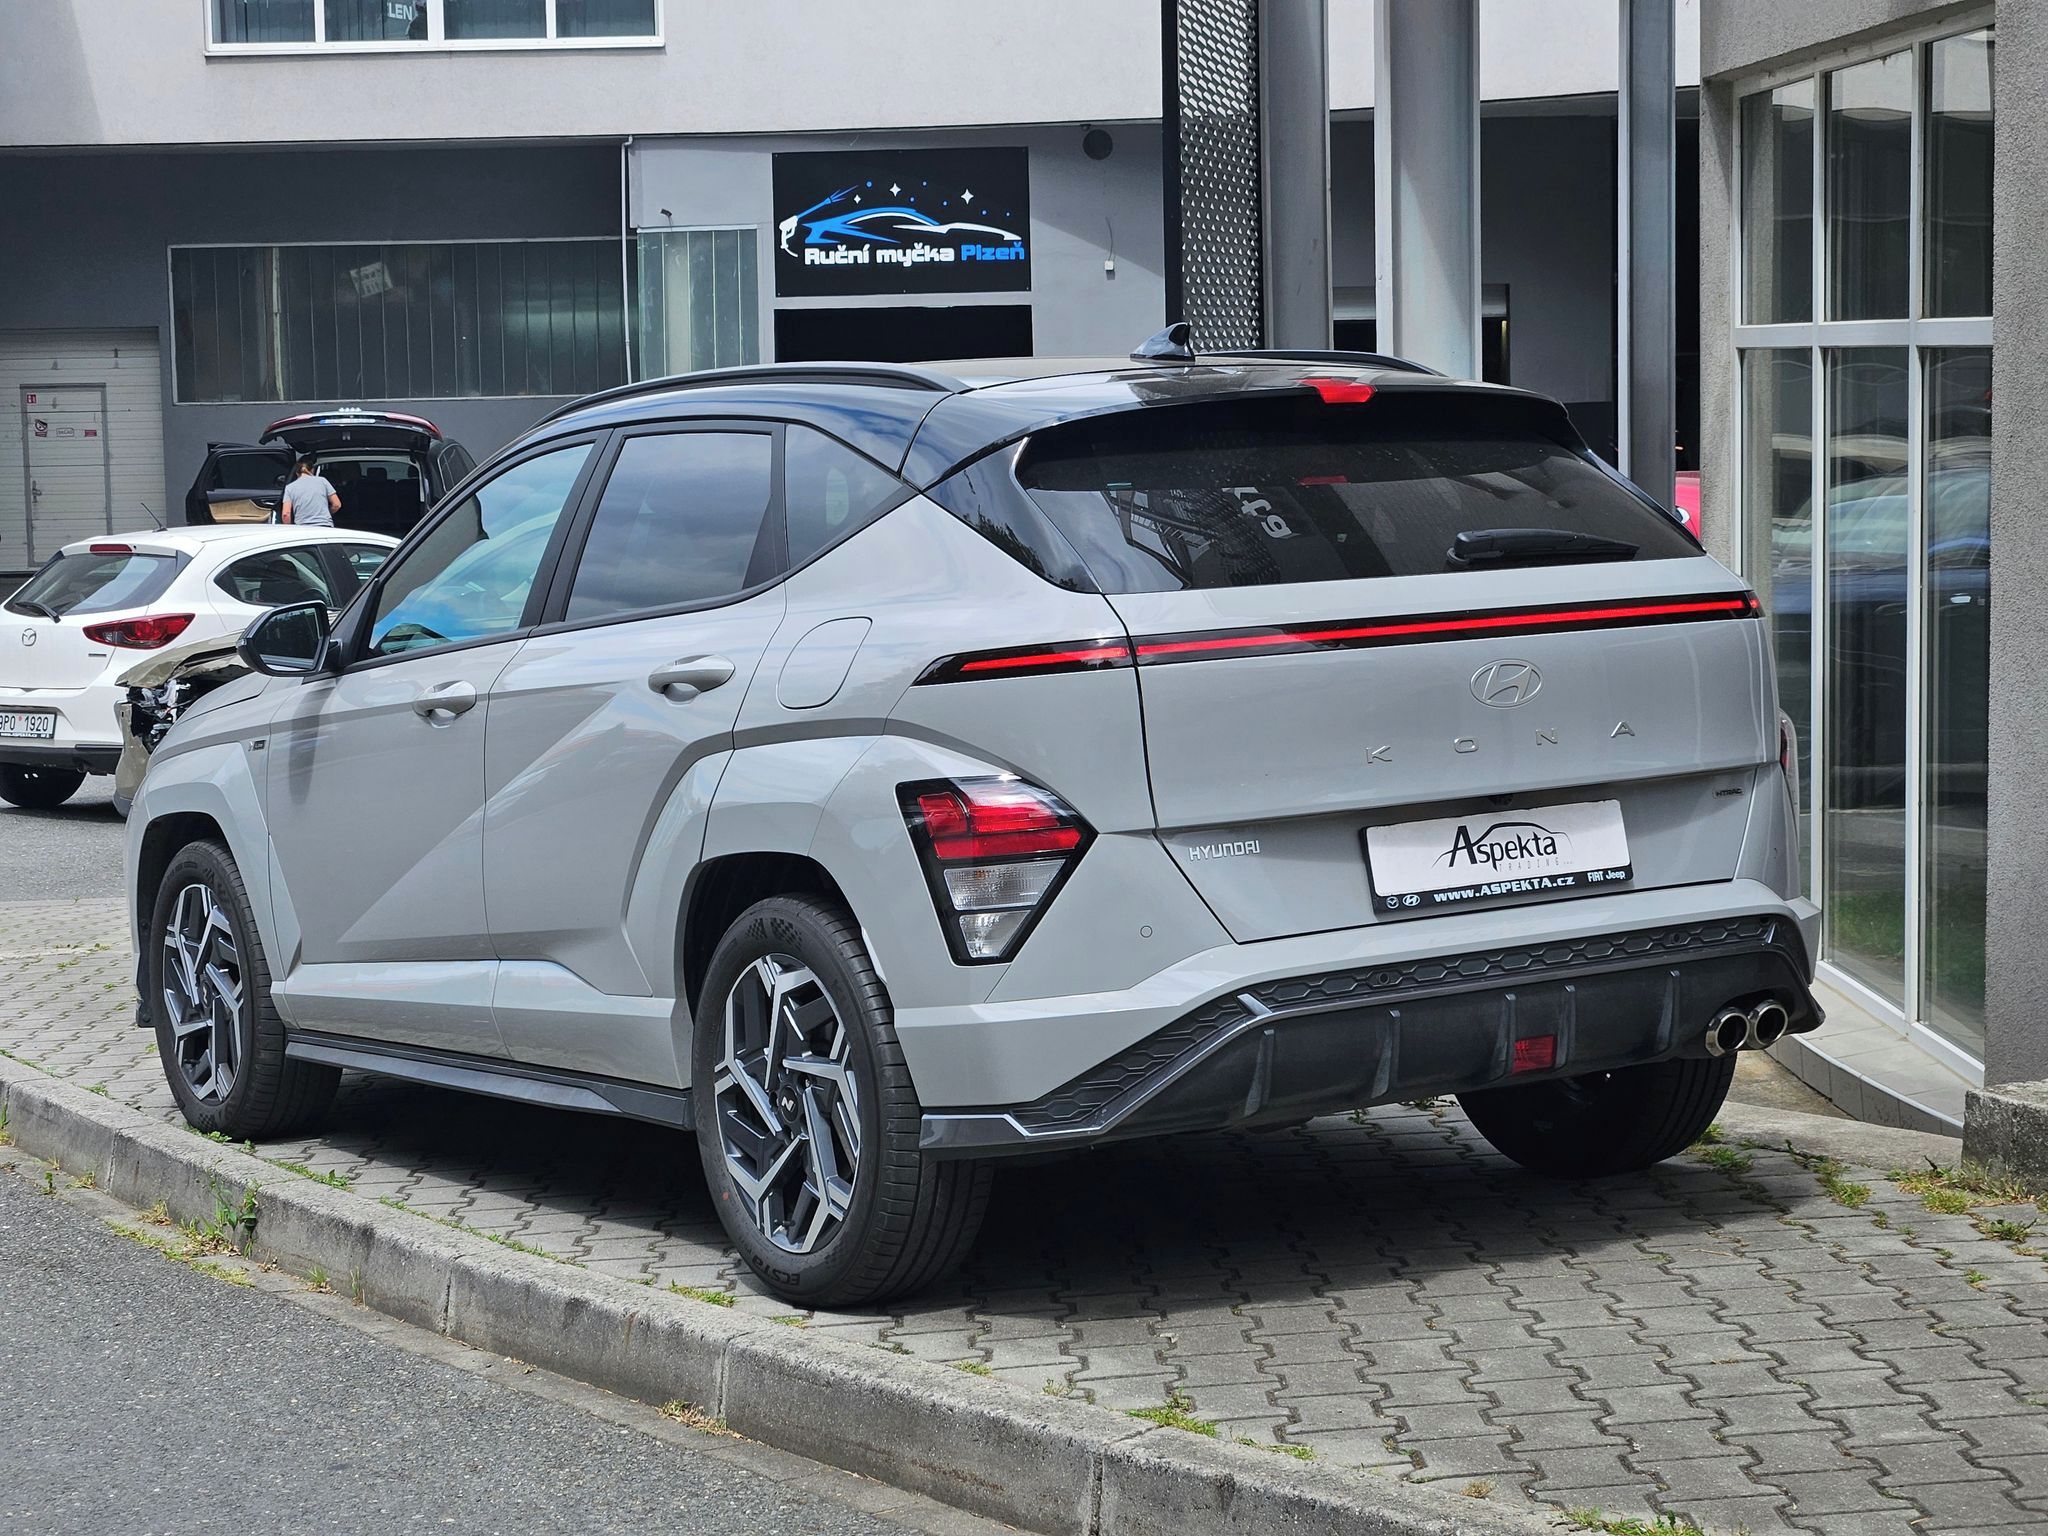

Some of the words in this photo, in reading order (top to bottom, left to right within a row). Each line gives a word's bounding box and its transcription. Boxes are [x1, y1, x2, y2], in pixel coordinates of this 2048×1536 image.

[804, 243, 870, 265] Ruční
[876, 242, 955, 267] myčka
[961, 241, 1025, 261] Plzeň
[24, 715, 49, 732] 1920
[1365, 720, 1635, 763] KONA
[1189, 840, 1261, 862] HYUNDAI
[1447, 825, 1557, 872] Aspekta
[1586, 870, 1605, 883] FIAT
[1605, 869, 1626, 881] Jeep
